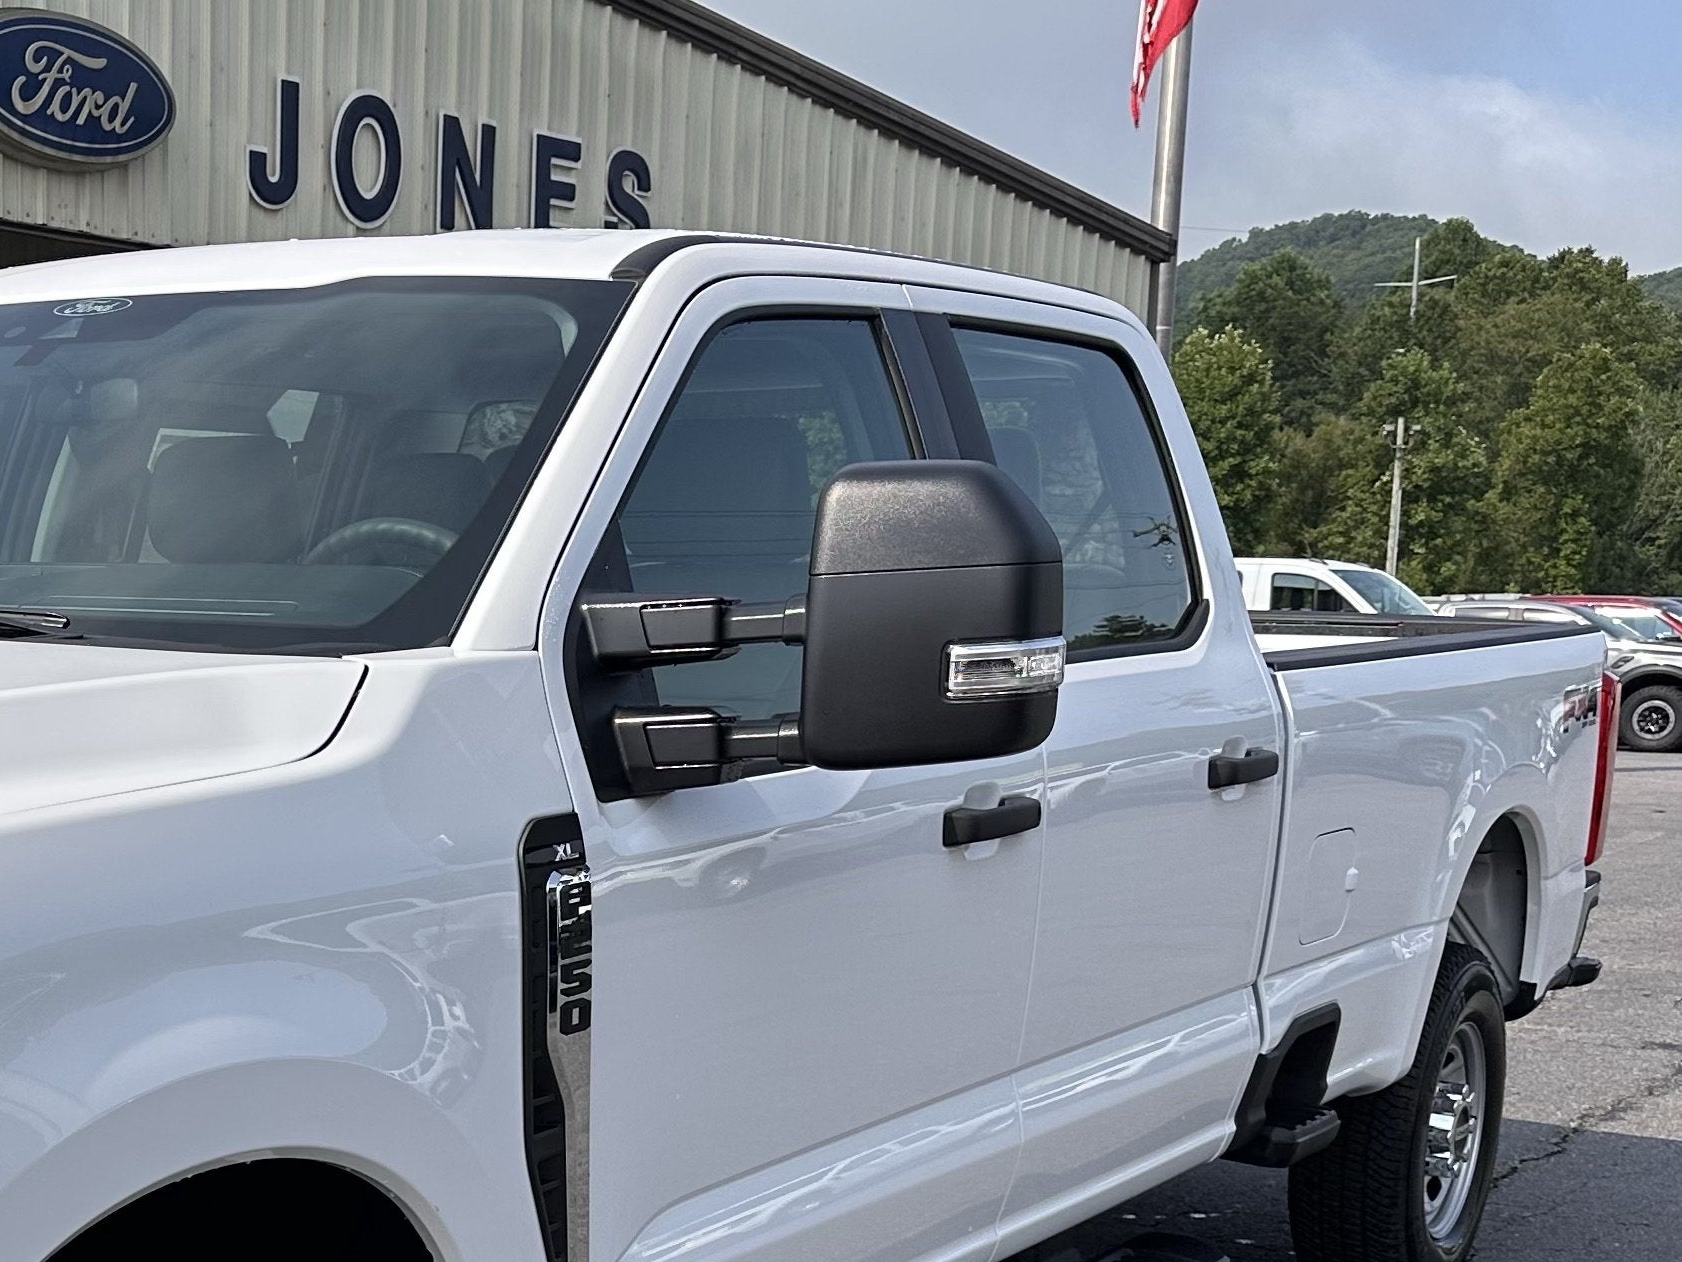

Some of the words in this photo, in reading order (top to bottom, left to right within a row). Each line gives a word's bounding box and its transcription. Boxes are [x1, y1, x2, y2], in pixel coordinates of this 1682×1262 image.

[11, 40, 140, 136] Ford
[247, 75, 653, 231] JONES
[552, 842, 580, 862] XL
